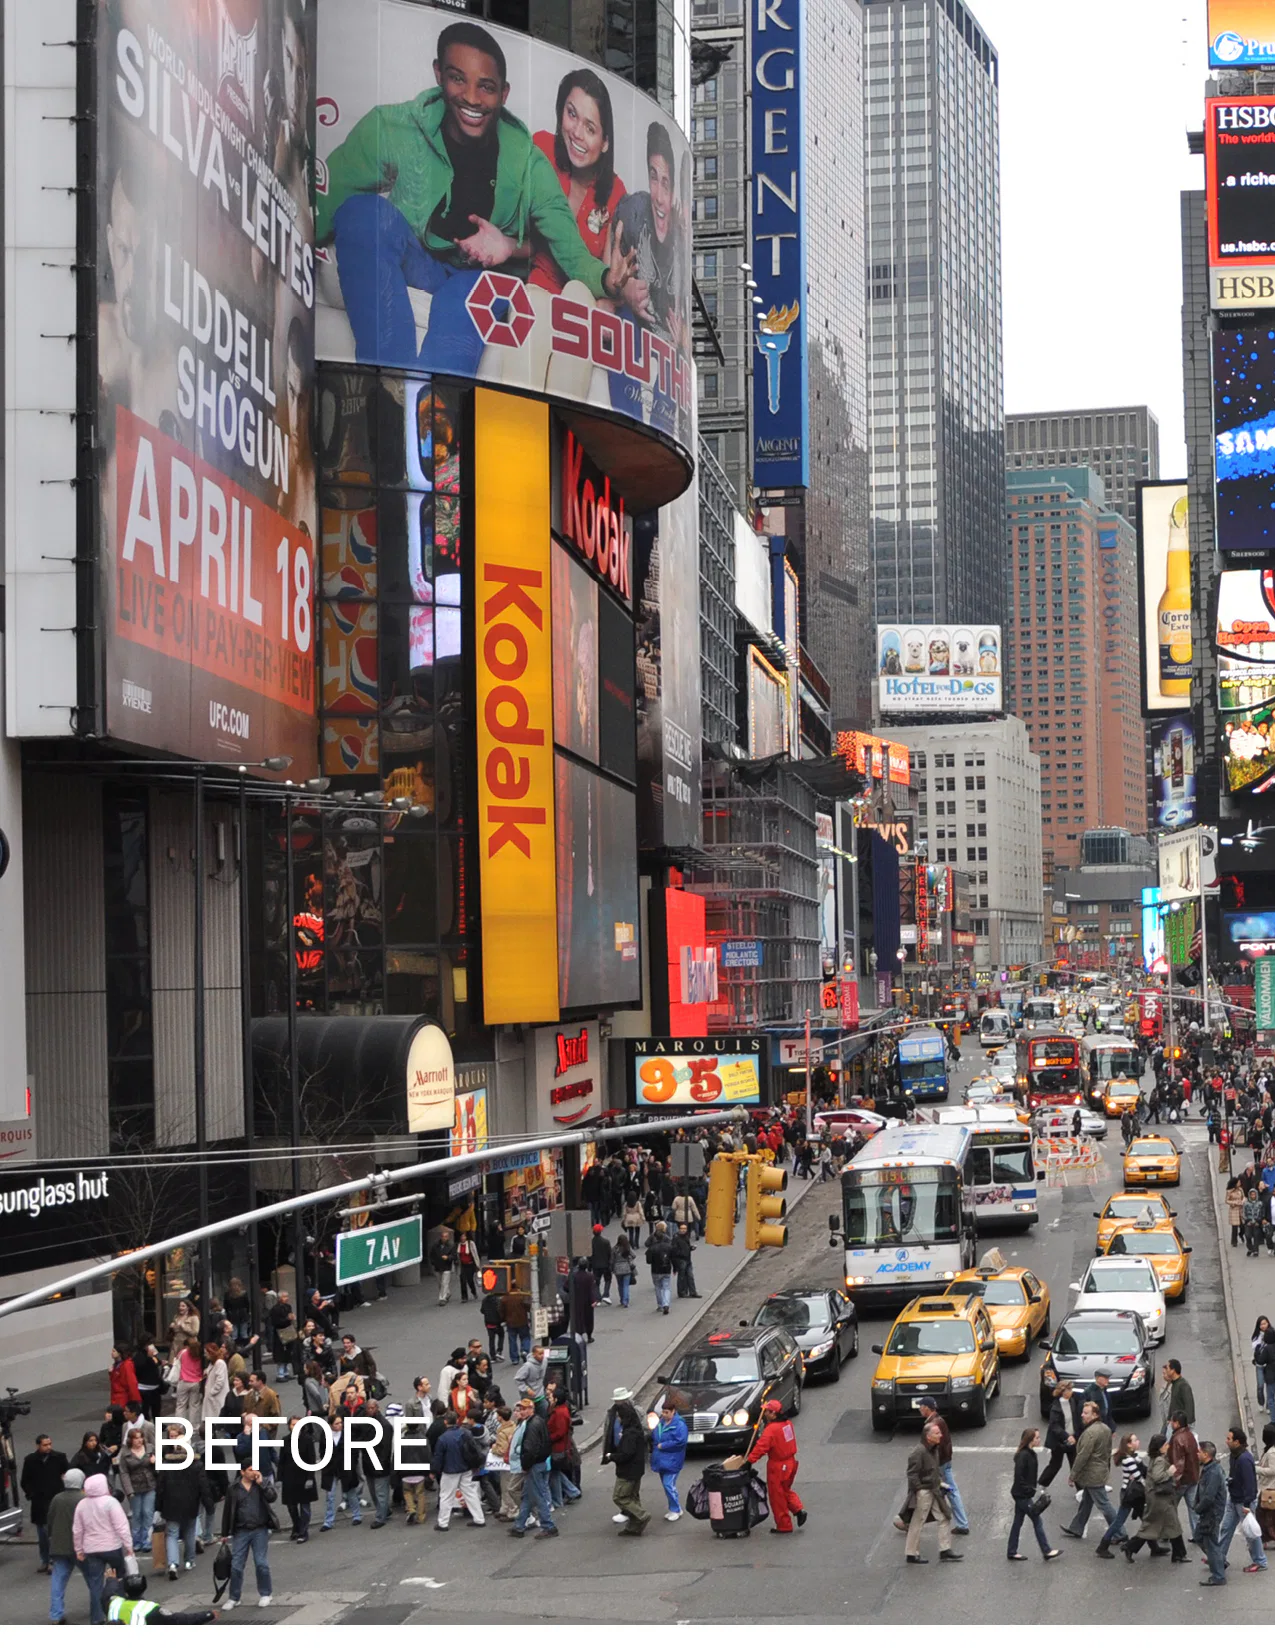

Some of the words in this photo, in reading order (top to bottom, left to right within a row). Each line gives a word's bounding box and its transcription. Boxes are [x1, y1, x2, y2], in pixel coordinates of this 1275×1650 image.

[147, 23, 185, 85] WORLD
[117, 28, 229, 212] SILVA
[1218, 134, 1239, 144] The
[242, 162, 313, 309] LEITES
[164, 243, 276, 408] LIDDELL
[177, 345, 289, 494] SHOGUN
[756, 436, 800, 454] ARGENT
[562, 430, 630, 600] Kodak
[122, 436, 262, 627] APRIL
[276, 536, 311, 652] 18
[118, 567, 165, 636] LIVE
[172, 591, 199, 647] ON
[1232, 620, 1269, 633] Open
[886, 677, 938, 695] HOTEL
[950, 679, 995, 695] DOGS
[209, 700, 249, 739] UFC.COM
[484, 563, 546, 859] Kodak
[1144, 991, 1158, 1019] tkts
[635, 1039, 760, 1053] MARQUIS
[413, 1068, 448, 1087] Marriott
[639, 1057, 677, 1103] 9
[688, 1058, 722, 1102] 5
[79, 1171, 109, 1200] hut
[366, 1239, 375, 1265] 7
[379, 1236, 400, 1263] Av
[876, 1261, 931, 1274] ACADEMY
[724, 1500, 745, 1508] SQUARE
